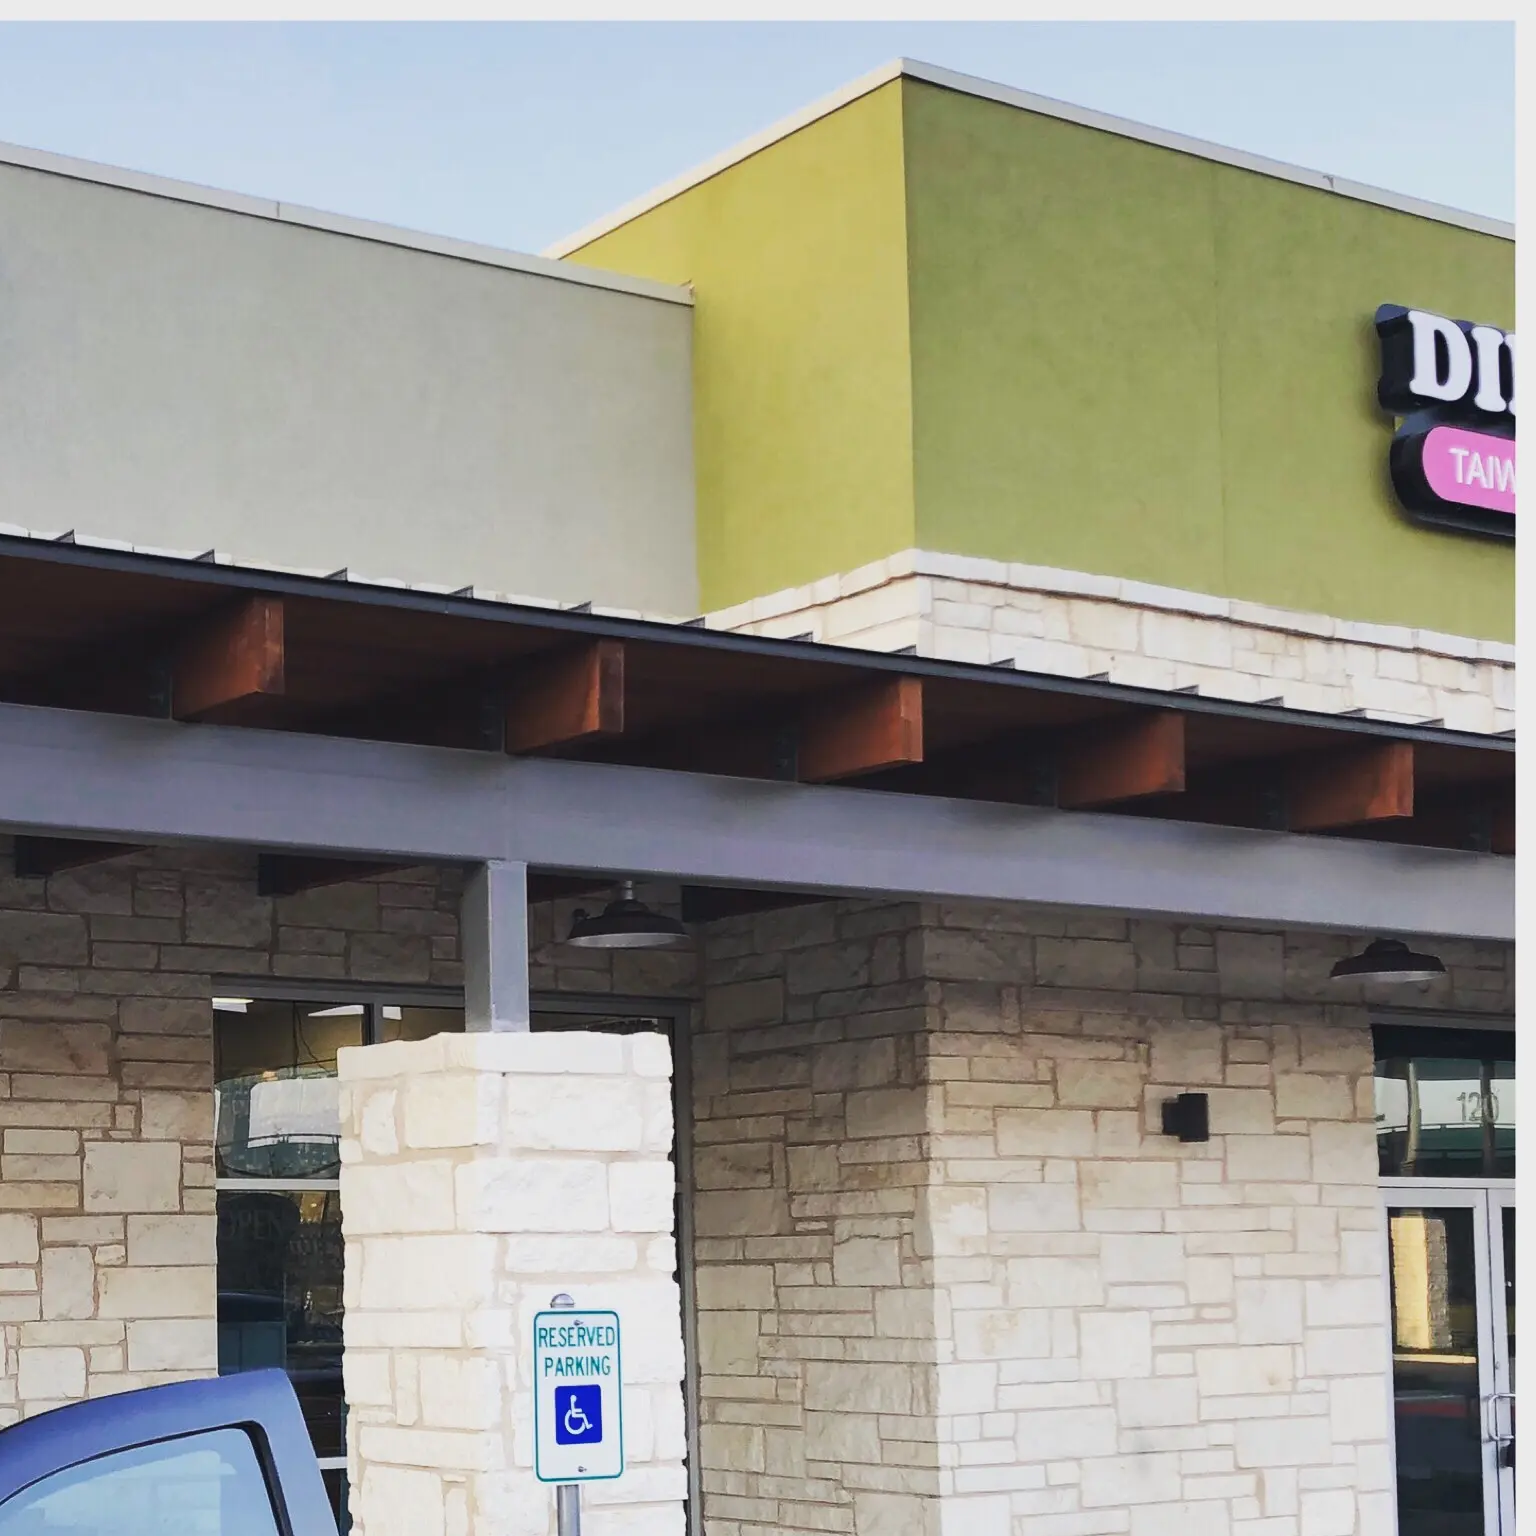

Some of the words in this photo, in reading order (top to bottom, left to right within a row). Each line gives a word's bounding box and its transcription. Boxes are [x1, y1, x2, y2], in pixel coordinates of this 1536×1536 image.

[1407, 309, 1515, 416] DI
[1456, 1091, 1500, 1123] 120
[538, 1326, 615, 1348] RESERVED
[544, 1356, 611, 1377] PARKING
